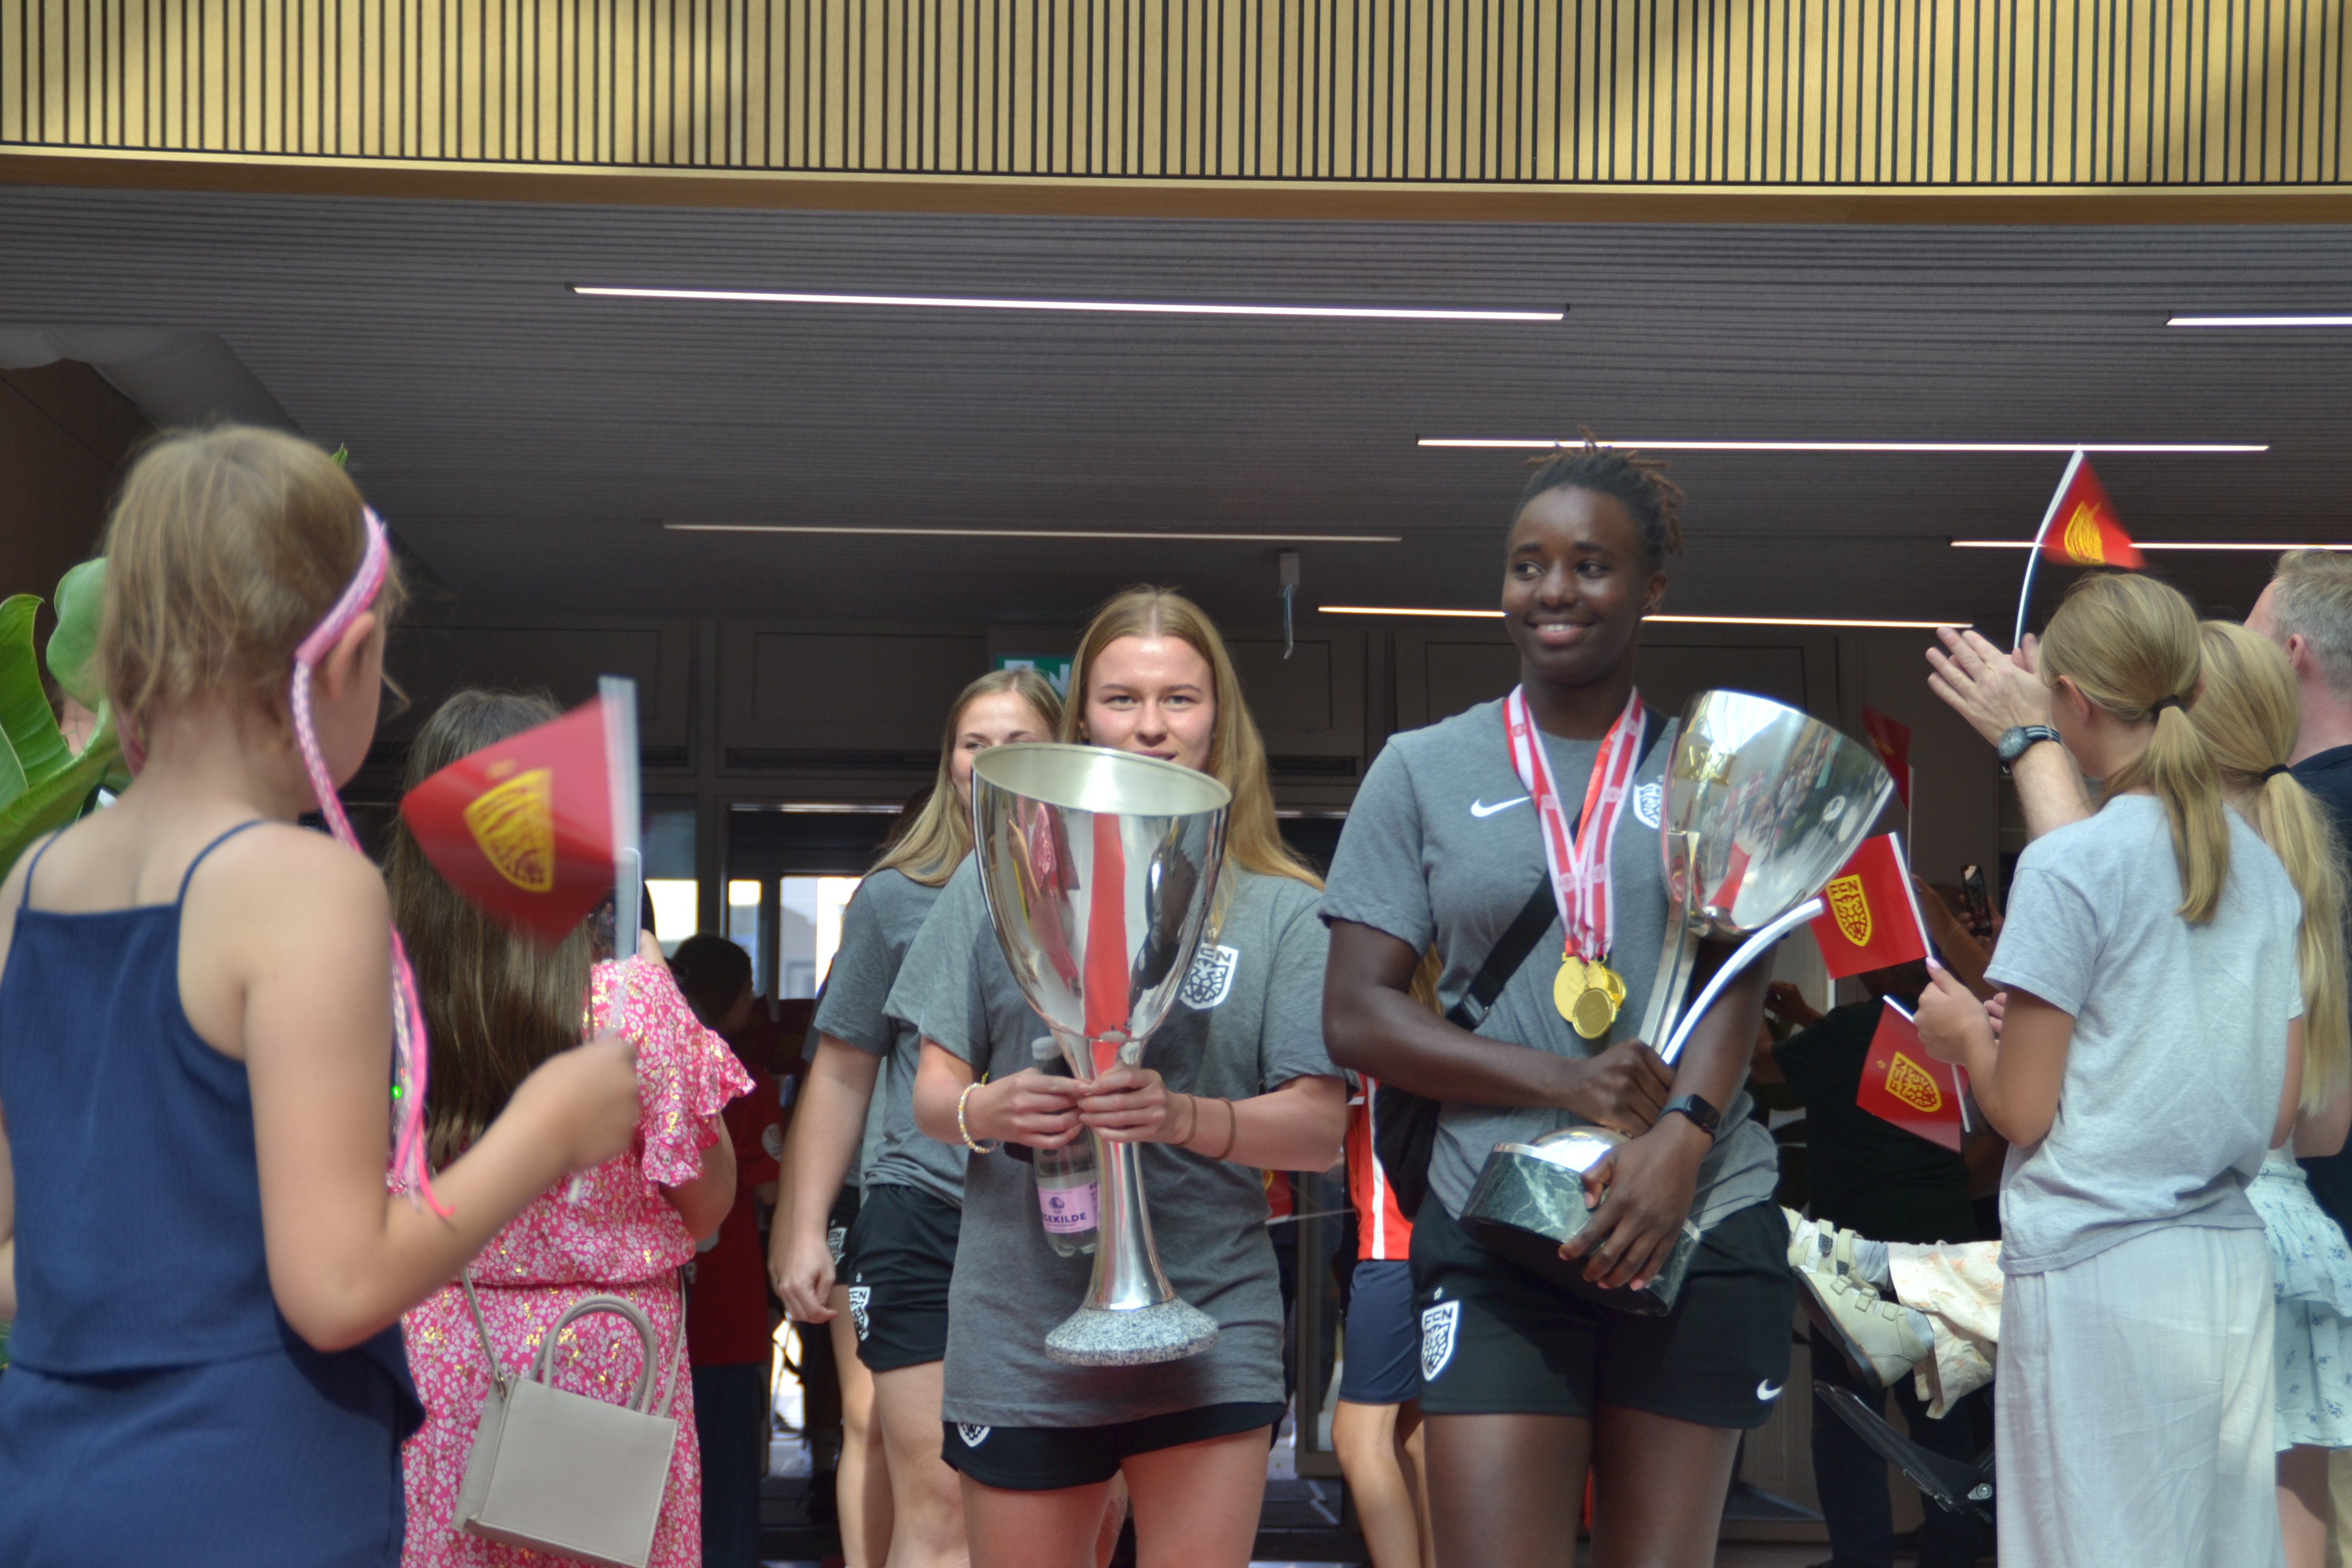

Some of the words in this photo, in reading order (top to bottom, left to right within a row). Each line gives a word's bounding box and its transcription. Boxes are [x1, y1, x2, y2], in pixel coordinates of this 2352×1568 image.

[1200, 947, 1232, 963] CN
[1043, 1212, 1086, 1223] GEKILDE
[1425, 1308, 1453, 1327] FCN
